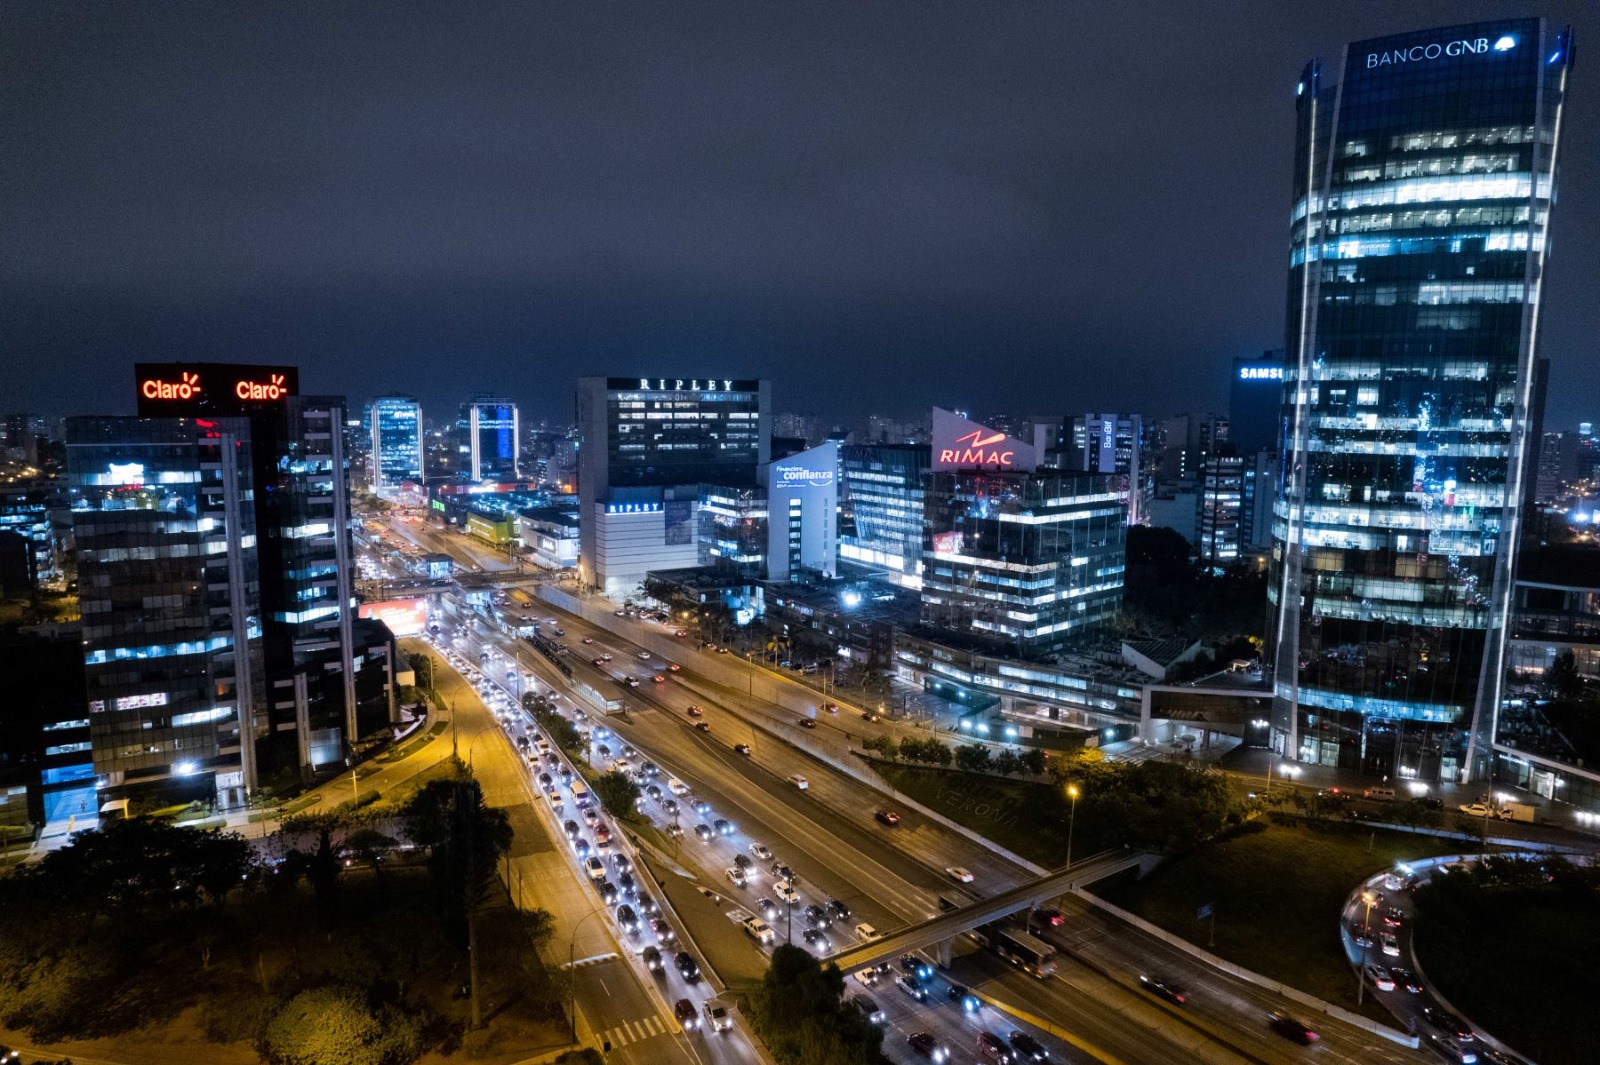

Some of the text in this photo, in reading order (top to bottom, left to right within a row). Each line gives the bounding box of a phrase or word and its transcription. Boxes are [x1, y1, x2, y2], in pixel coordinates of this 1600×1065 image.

[1367, 38, 1488, 69] BANCO GNB
[142, 380, 192, 399] Claro
[236, 381, 279, 399] Claro
[640, 379, 732, 391] RIPLEY
[1103, 421, 1112, 448] BanBif
[940, 449, 1014, 465] RIMAC
[783, 469, 833, 480] confianza
[609, 503, 659, 513] RIPLEY
[936, 785, 1019, 827] VERONA
